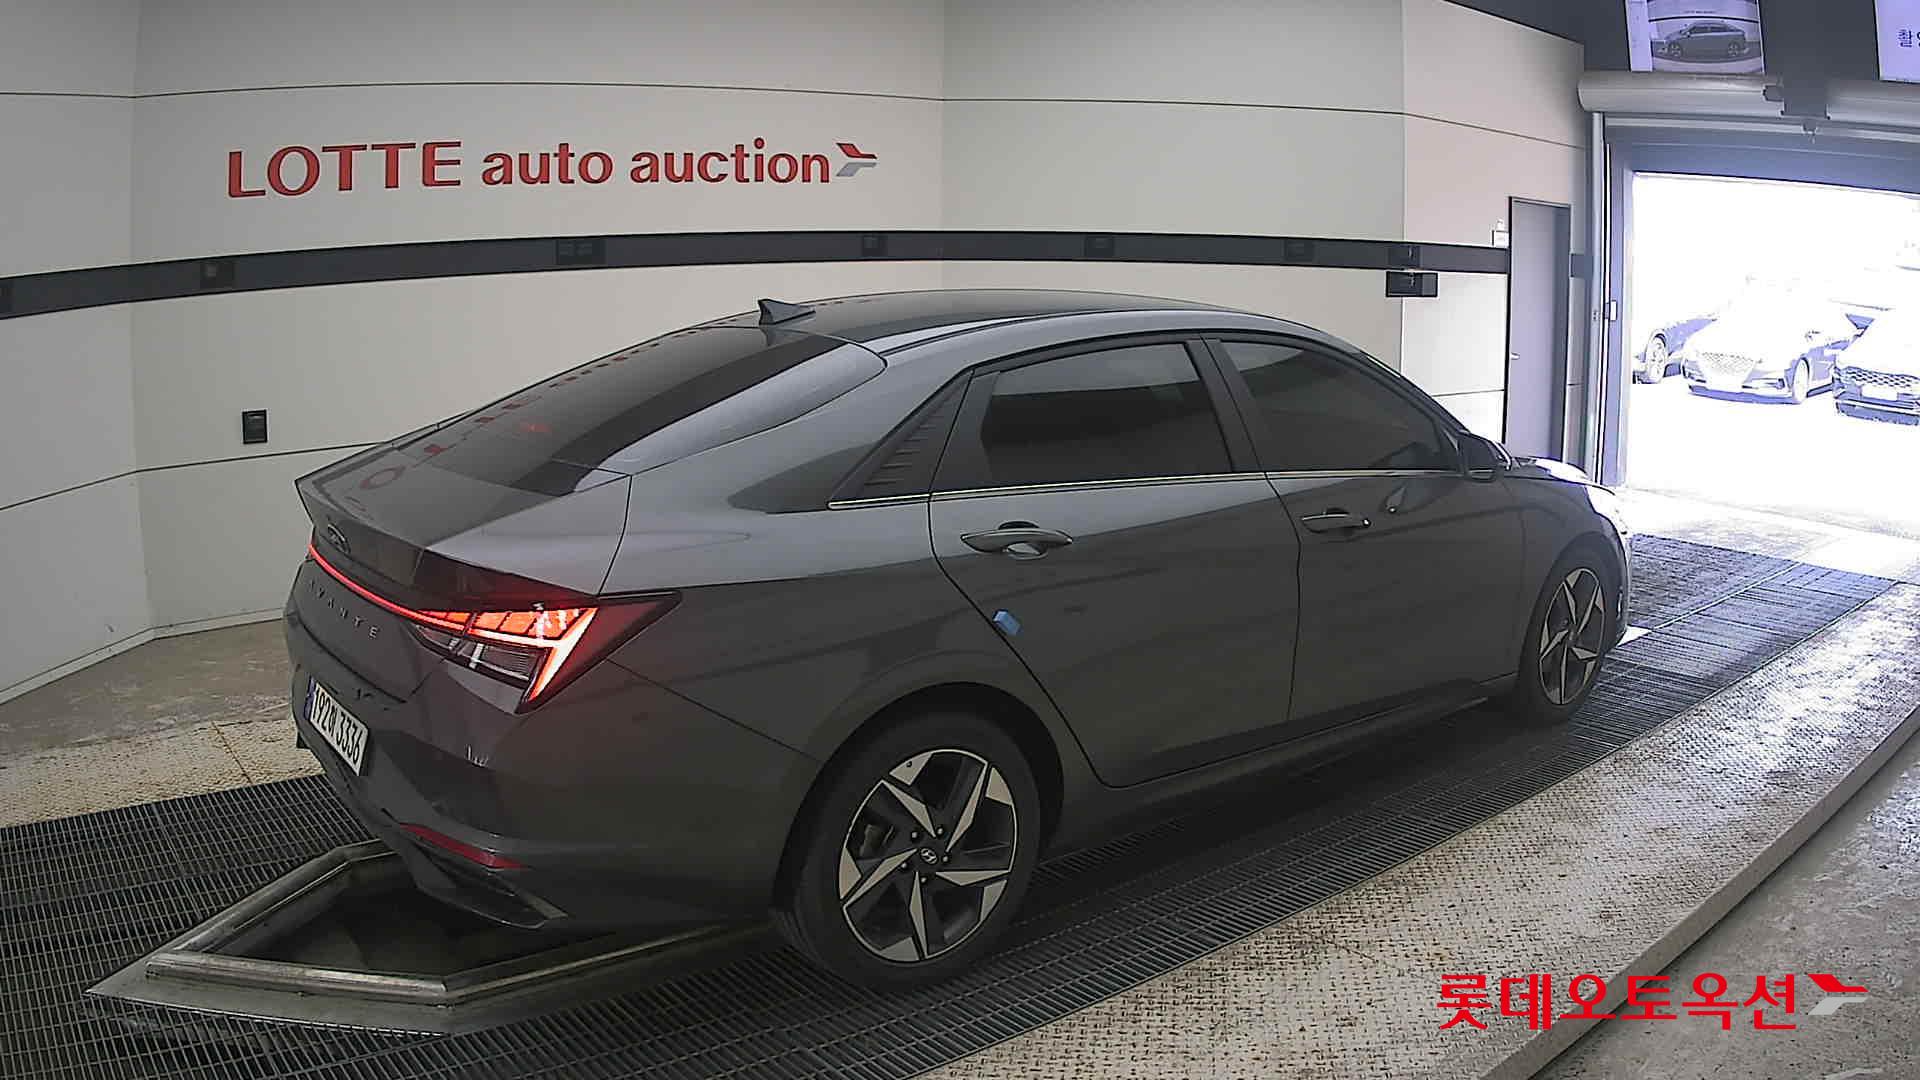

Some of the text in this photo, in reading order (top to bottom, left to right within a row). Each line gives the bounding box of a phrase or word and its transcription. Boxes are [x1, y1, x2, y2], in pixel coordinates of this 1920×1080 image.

[228, 138, 833, 198] LOTTE auto auction
[336, 711, 363, 764] 3336
